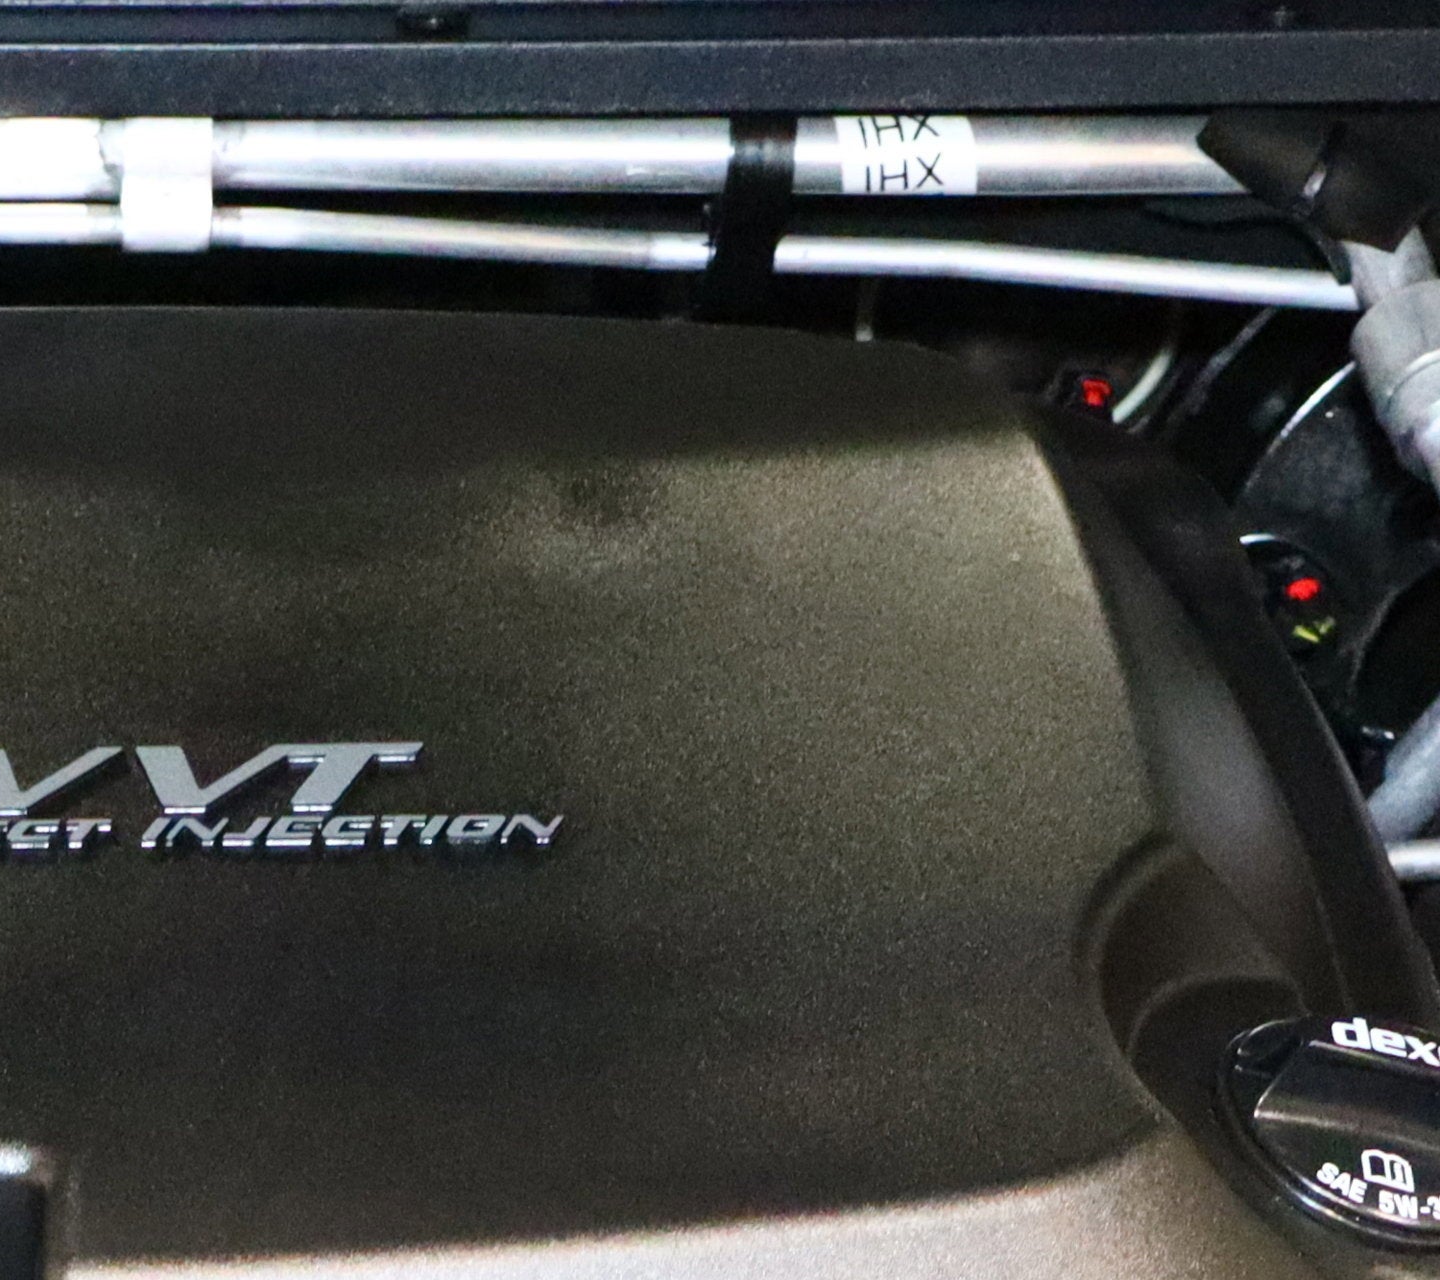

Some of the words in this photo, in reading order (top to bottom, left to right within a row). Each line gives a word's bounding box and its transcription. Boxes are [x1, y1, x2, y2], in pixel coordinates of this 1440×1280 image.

[865, 153, 944, 192] IHX
[140, 811, 565, 853] INJECTION
[1316, 1162, 1368, 1203] SAE
